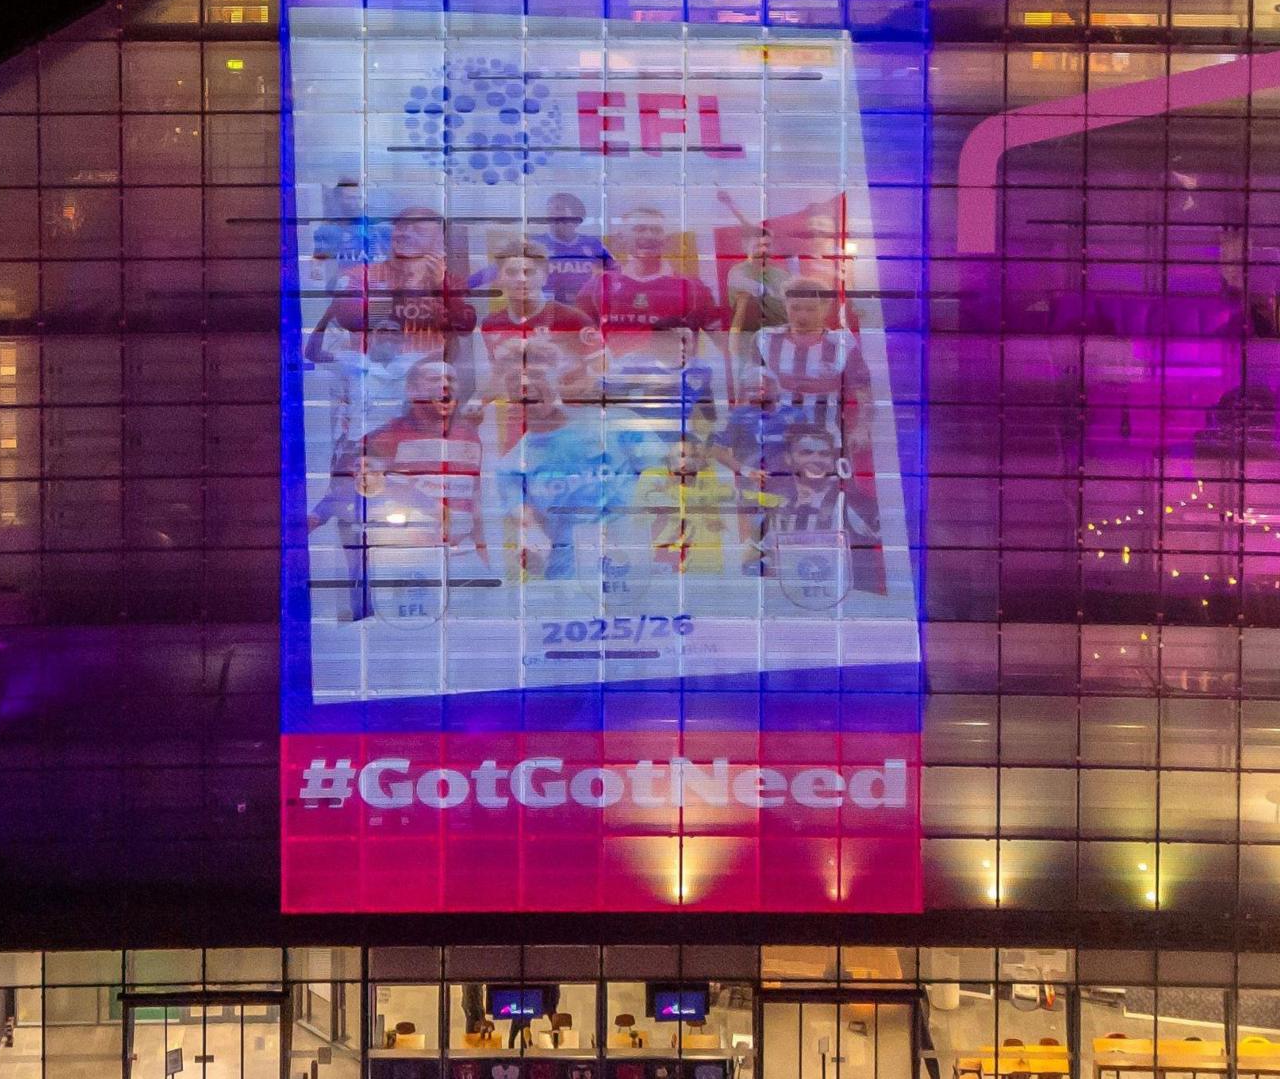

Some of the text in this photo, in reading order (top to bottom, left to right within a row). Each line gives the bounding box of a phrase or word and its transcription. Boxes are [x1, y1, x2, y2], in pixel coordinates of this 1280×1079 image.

[576, 90, 747, 159] EFL
[541, 614, 695, 646] 2025/26
[299, 756, 908, 809] #GotGotNeed
